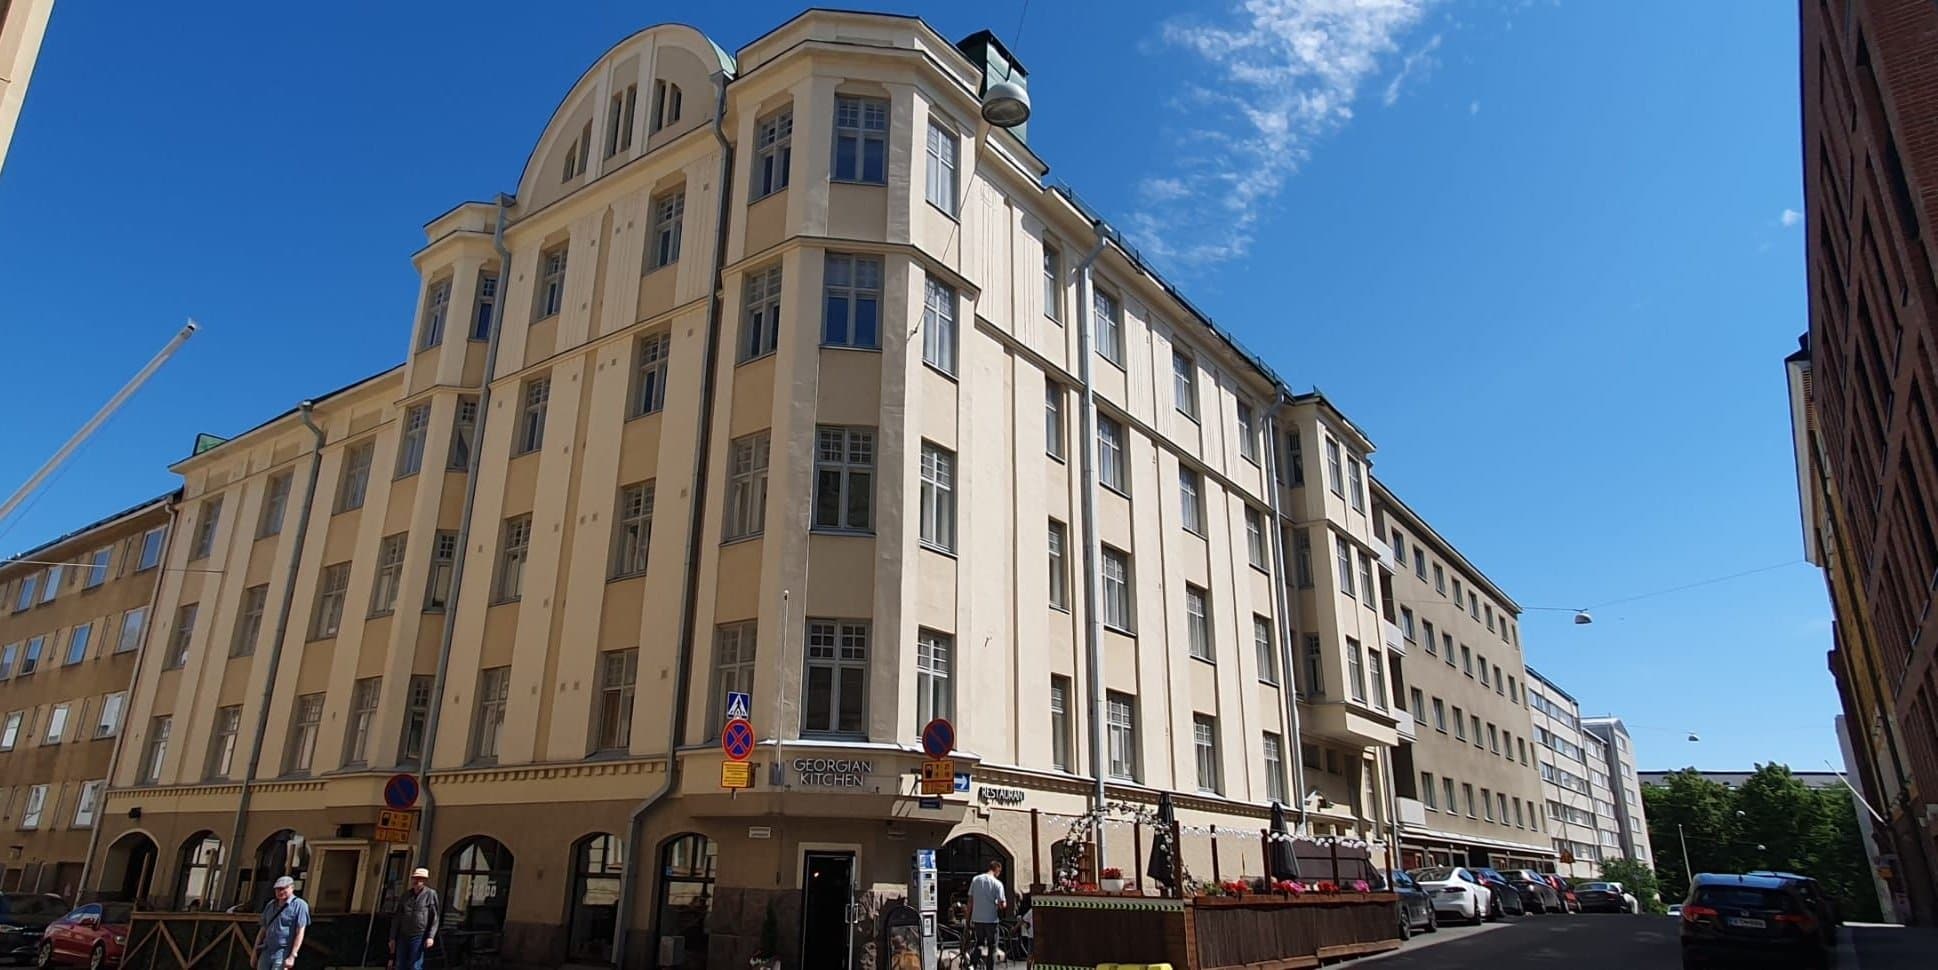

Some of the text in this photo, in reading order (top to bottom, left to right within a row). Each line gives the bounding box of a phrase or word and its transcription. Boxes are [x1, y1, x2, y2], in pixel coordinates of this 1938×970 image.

[793, 758, 872, 773] GEORGIAN
[800, 773, 864, 787] KITCHEN
[980, 786, 1025, 801] RESTAURAN
